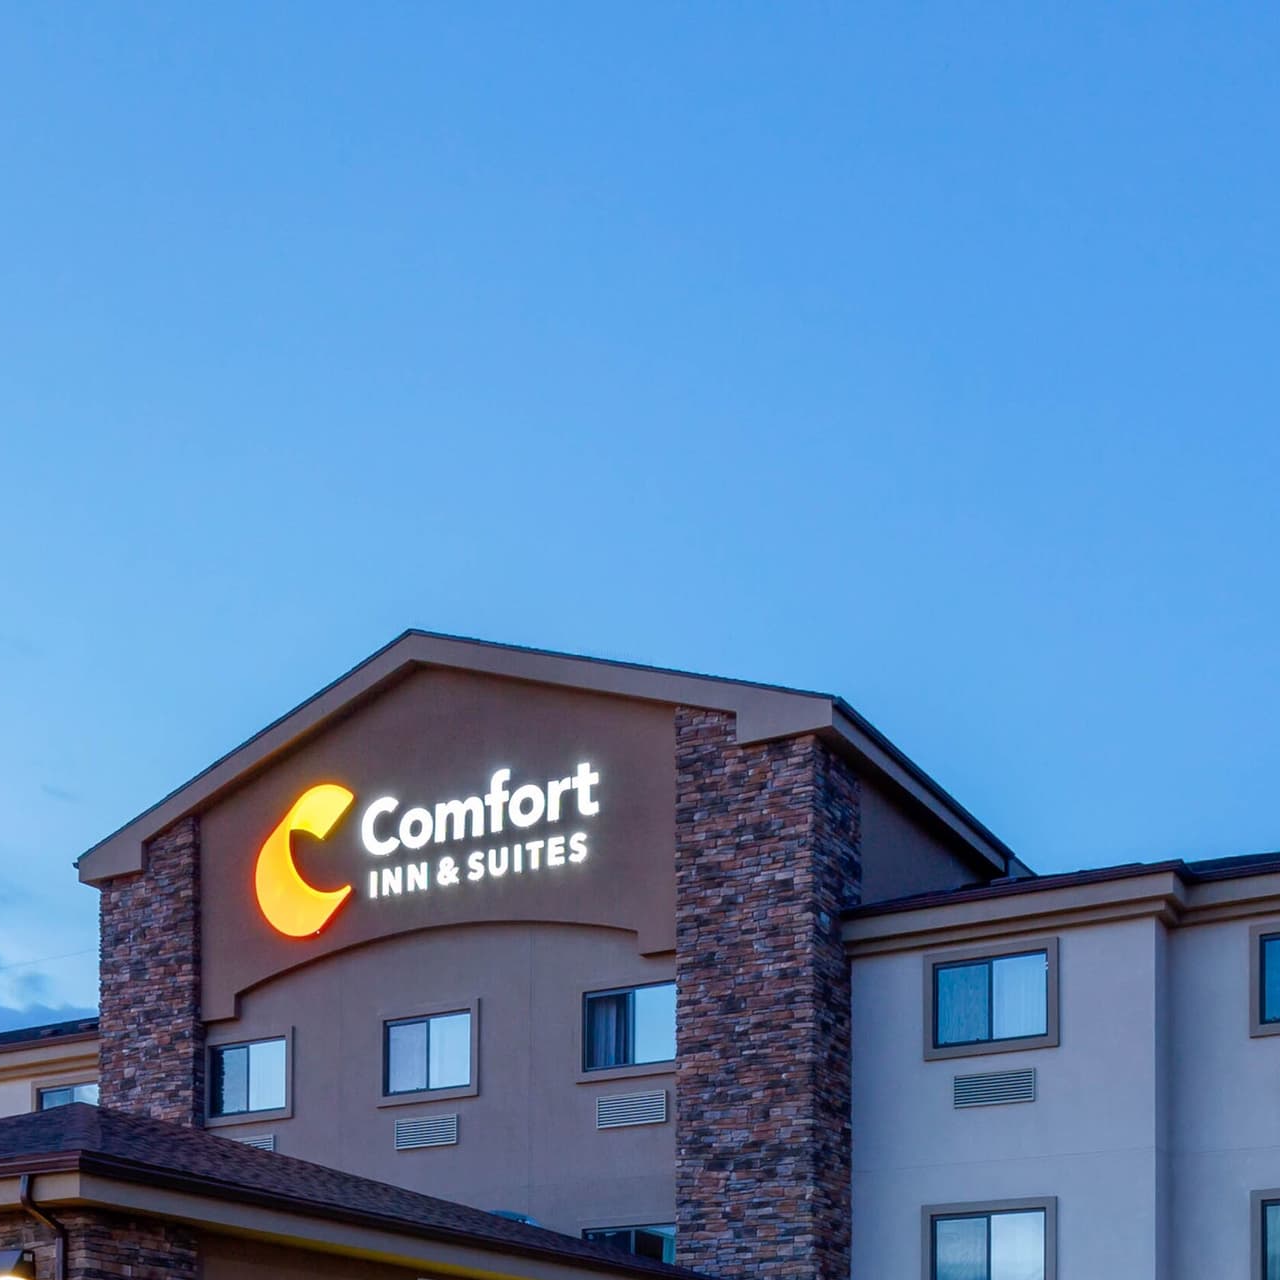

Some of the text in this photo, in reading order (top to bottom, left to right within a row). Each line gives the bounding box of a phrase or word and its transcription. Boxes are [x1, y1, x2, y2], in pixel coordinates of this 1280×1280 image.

[361, 762, 600, 856] Comfort
[368, 831, 589, 899] INN & SUITES
